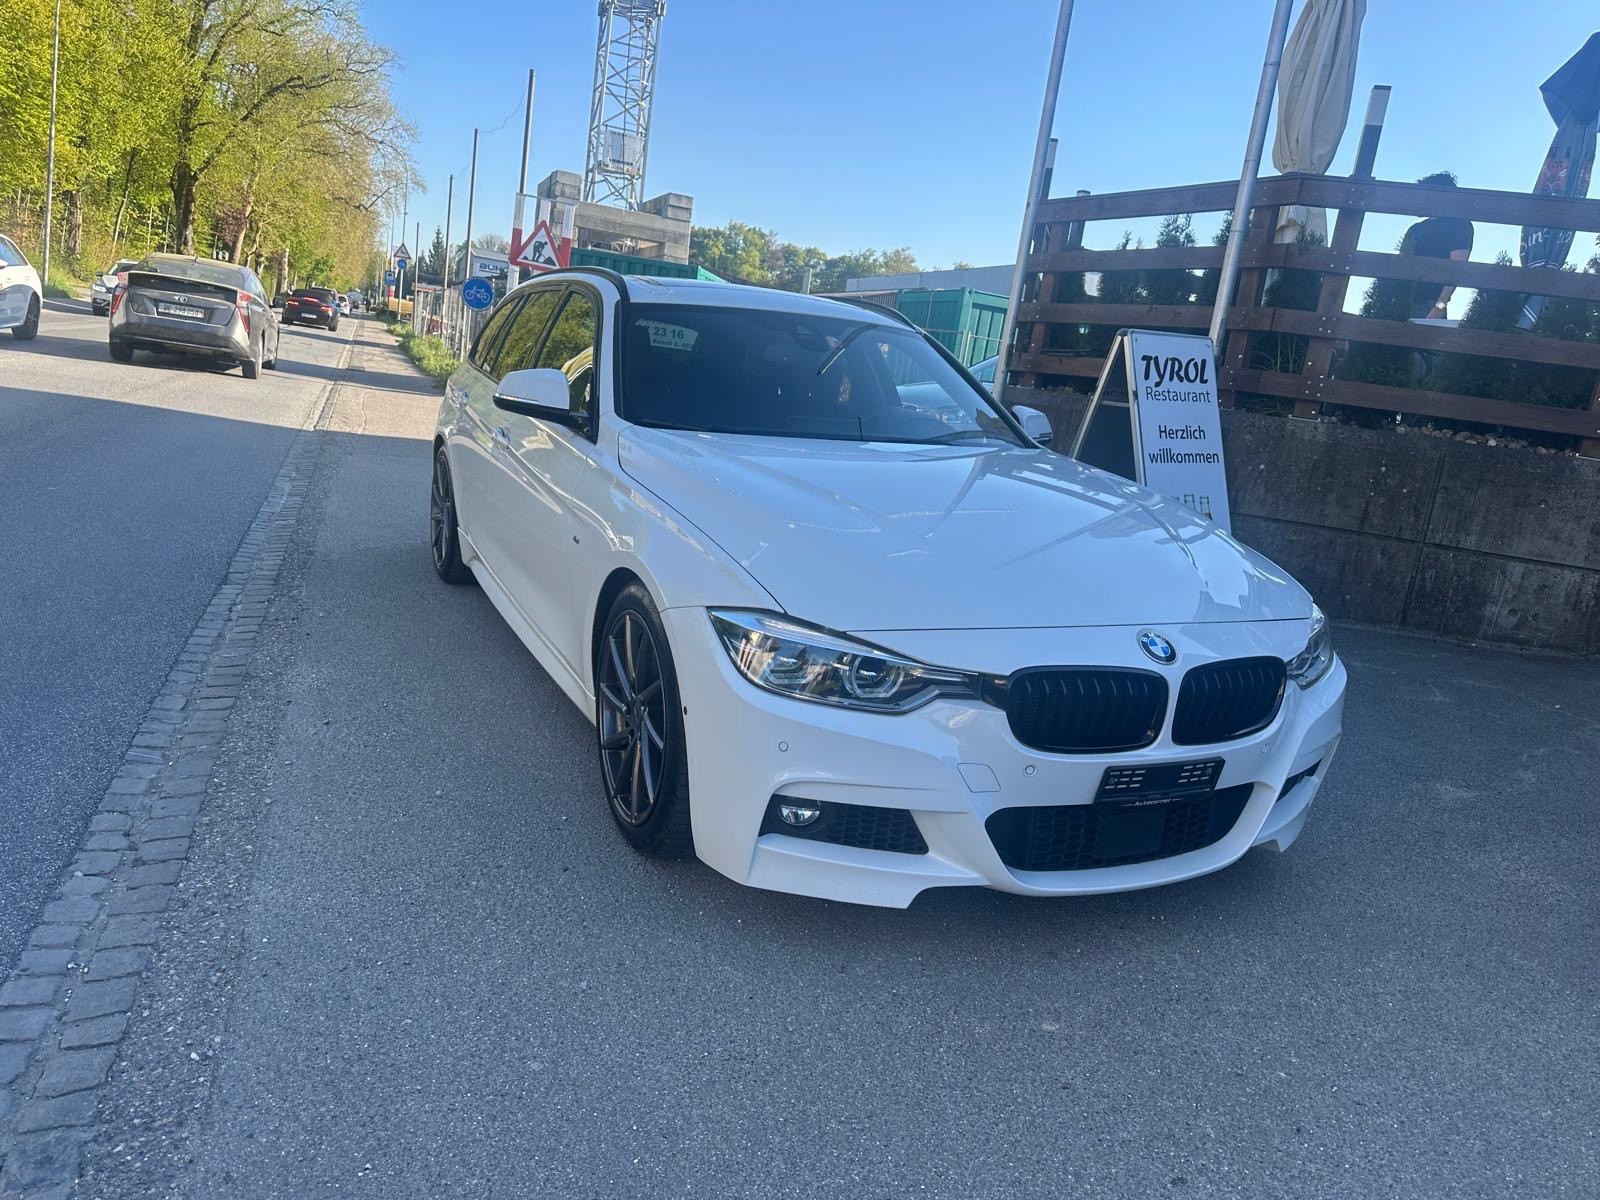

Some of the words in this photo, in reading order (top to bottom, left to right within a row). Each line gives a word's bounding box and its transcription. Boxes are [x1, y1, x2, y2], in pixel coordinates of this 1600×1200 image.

[653, 326, 667, 337] 23
[671, 329, 684, 339] 16
[1141, 354, 1209, 388] TYROL
[1145, 386, 1211, 403] Restaurant
[1158, 424, 1206, 440] Herzlich
[1148, 448, 1220, 464] willkommen
